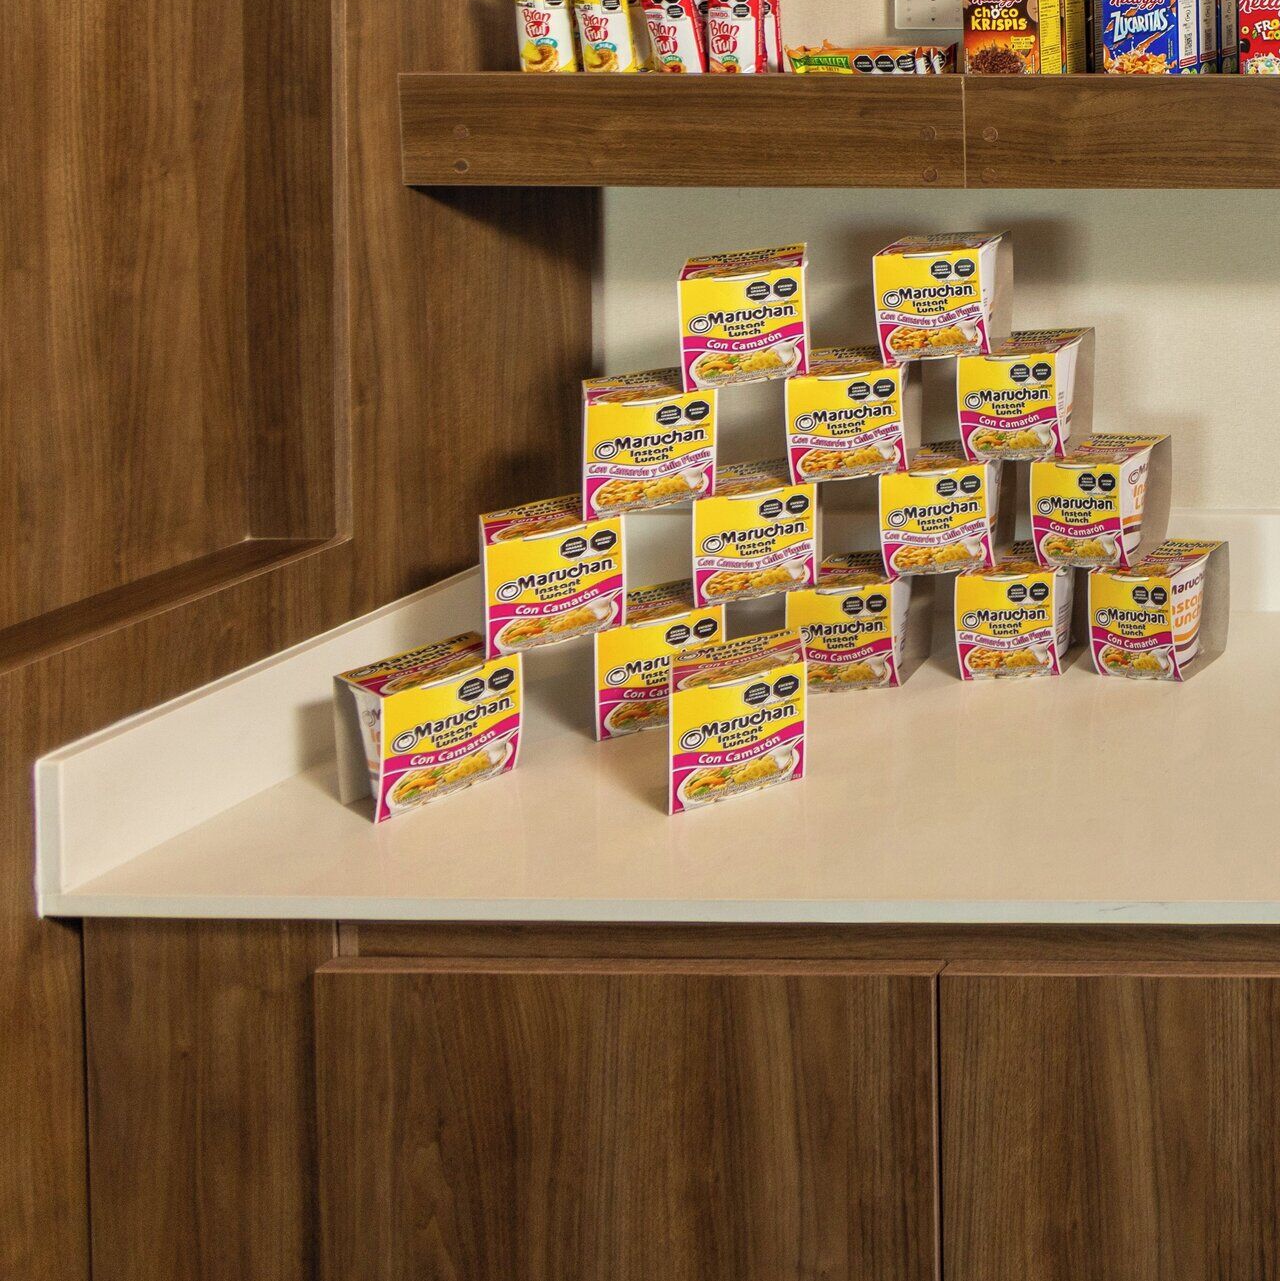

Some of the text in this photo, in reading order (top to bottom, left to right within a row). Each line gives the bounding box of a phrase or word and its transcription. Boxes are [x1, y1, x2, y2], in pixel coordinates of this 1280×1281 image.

[523, 9, 551, 22] Bran
[582, 14, 608, 27] Bran
[648, 21, 676, 36] Bran
[709, 20, 739, 35] Bran
[1110, 8, 1168, 43] ZUCARITAS
[820, 57, 847, 68] VALLEY
[899, 284, 972, 300] Maruchan
[913, 298, 948, 307] Instant
[708, 305, 794, 324] Maruchan
[723, 321, 765, 332] Instant
[728, 328, 761, 338] Lunch
[706, 332, 782, 351] Con Camarón
[979, 388, 1048, 402] Maruchan
[992, 402, 1025, 410] Instant
[813, 406, 892, 422] Maruchan
[979, 414, 1040, 429] Con Camarón
[827, 420, 866, 430] Instant
[832, 427, 862, 436] Lunch
[615, 429, 704, 451] Maruchan
[630, 446, 674, 457] Instant
[635, 454, 669, 464] Lunch
[904, 501, 977, 519] Maruchan
[1051, 497, 1113, 510] Maruchan
[1061, 509, 1092, 517] Instant
[1065, 516, 1089, 524] Lunch
[917, 516, 953, 526] Instant
[922, 524, 950, 532] Lunch
[721, 522, 804, 543] Maruchan
[1050, 522, 1105, 536] Con Camarón
[736, 538, 776, 551] Instant
[740, 547, 772, 557] Lunch
[517, 559, 612, 589] Maruchan
[535, 578, 581, 595] Instant
[540, 587, 576, 601] Lunch
[515, 588, 599, 615] Con Camarón
[977, 608, 1045, 621] Maruchan
[1108, 609, 1165, 624] Maruchan
[810, 621, 883, 636] Maruchan
[822, 635, 858, 644] Instant
[1107, 634, 1158, 649] Con Camarón
[809, 647, 873, 662] Con Camarón
[626, 655, 670, 674] Maru
[414, 696, 510, 738] Maruchan
[701, 704, 794, 736] Maruchan
[430, 721, 478, 743] Instant
[718, 726, 763, 743] Instant
[410, 730, 496, 766] Con Camarón
[435, 732, 473, 749] Lunch
[723, 735, 758, 749] Lunch
[698, 735, 780, 764] Con Camarón
